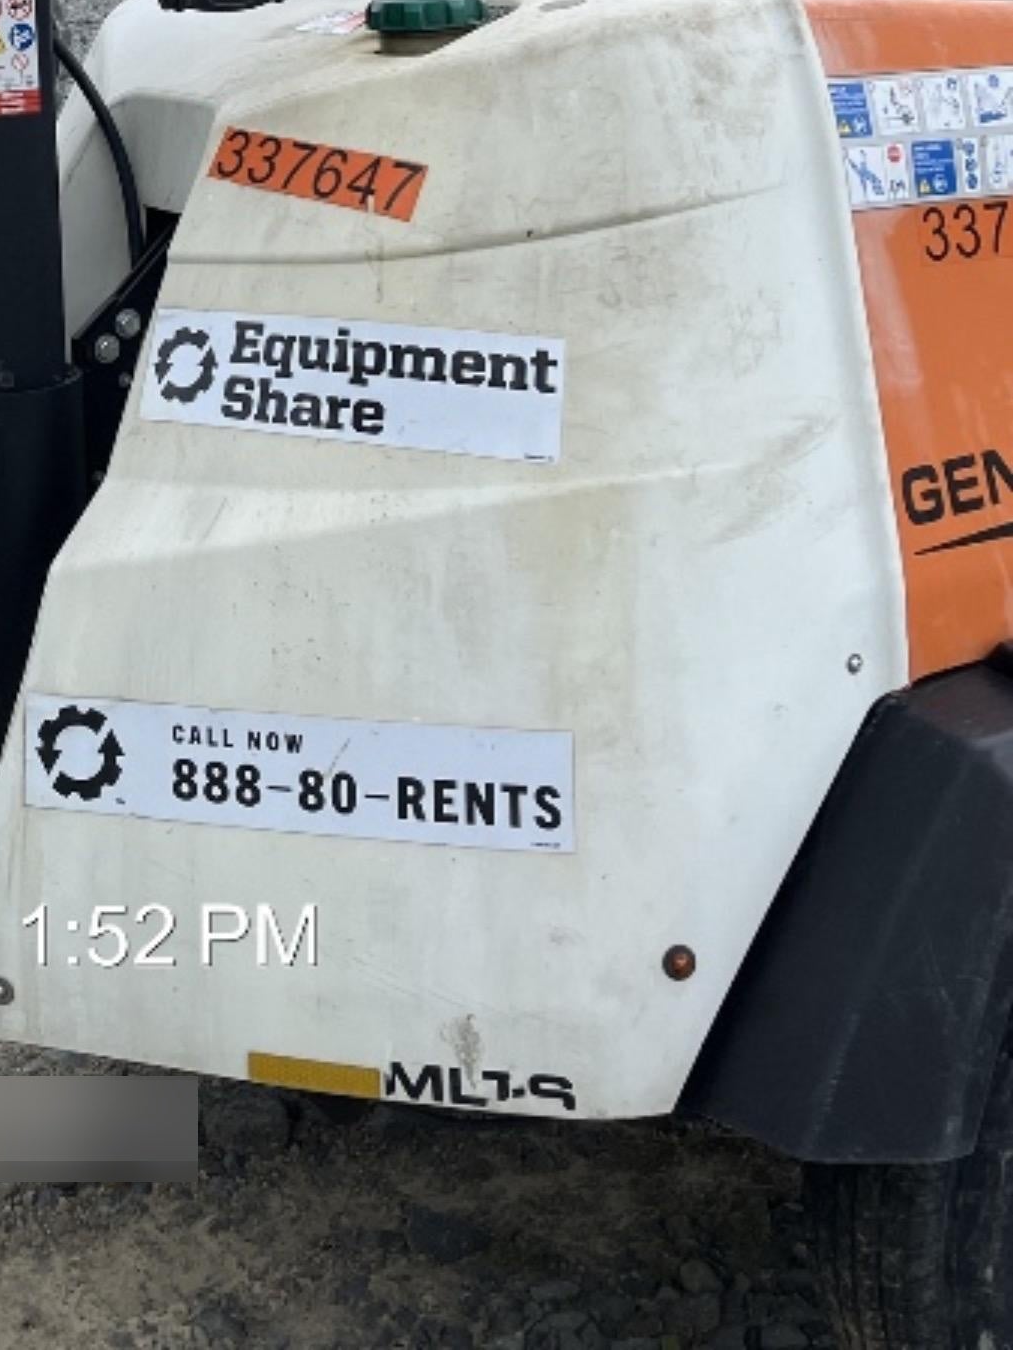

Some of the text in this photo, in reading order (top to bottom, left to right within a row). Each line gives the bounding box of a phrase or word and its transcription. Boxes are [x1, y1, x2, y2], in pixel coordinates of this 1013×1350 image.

[217, 129, 426, 212] 337647
[923, 201, 1009, 262] 337
[229, 320, 559, 394] Equipment
[220, 375, 385, 435] Share
[172, 724, 304, 754] CALL NOW
[172, 757, 563, 830] 888-80-RENTS
